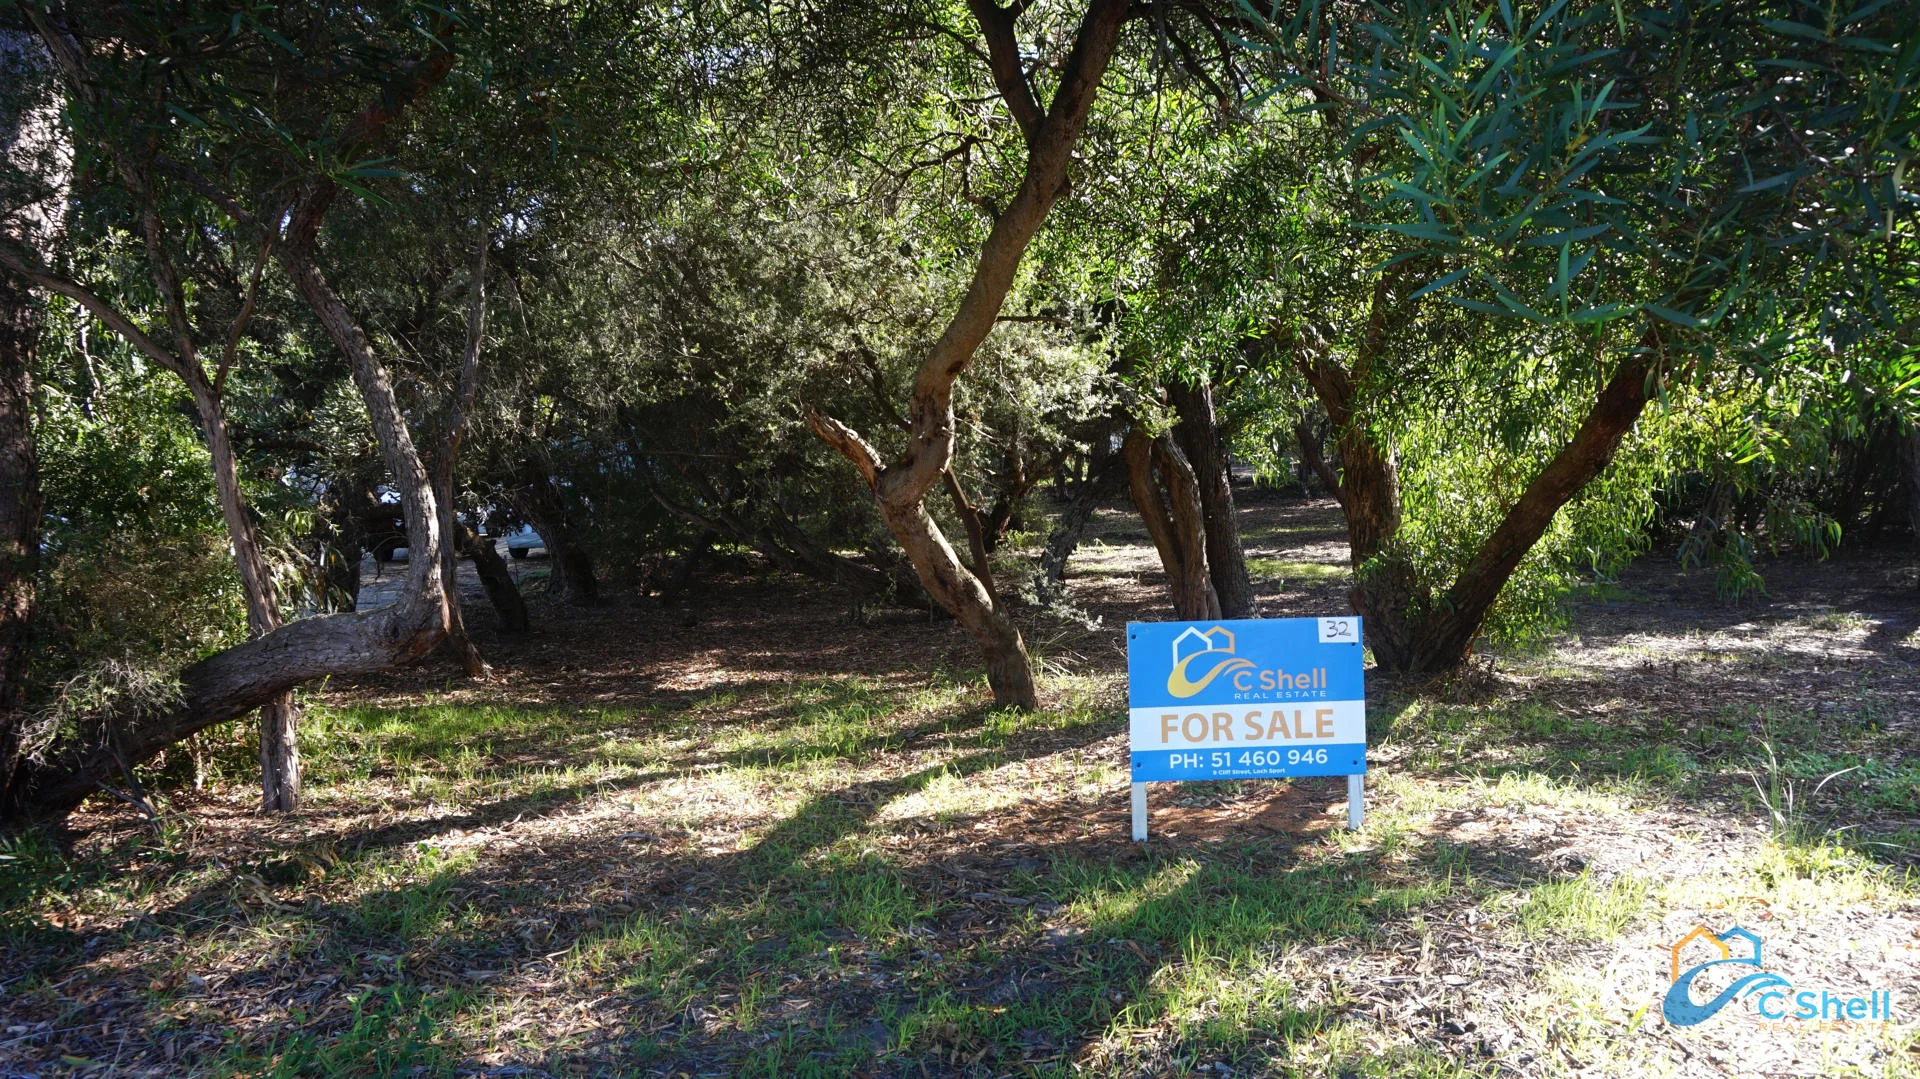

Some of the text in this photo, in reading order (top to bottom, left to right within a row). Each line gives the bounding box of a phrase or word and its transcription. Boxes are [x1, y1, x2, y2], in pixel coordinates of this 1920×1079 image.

[1326, 620, 1352, 638] 32
[1233, 668, 1327, 691] C Shell
[1234, 690, 1327, 700] REAL ESTATE
[1161, 709, 1335, 743] FOR SALE
[1169, 748, 1328, 769] PH: 51 460 946
